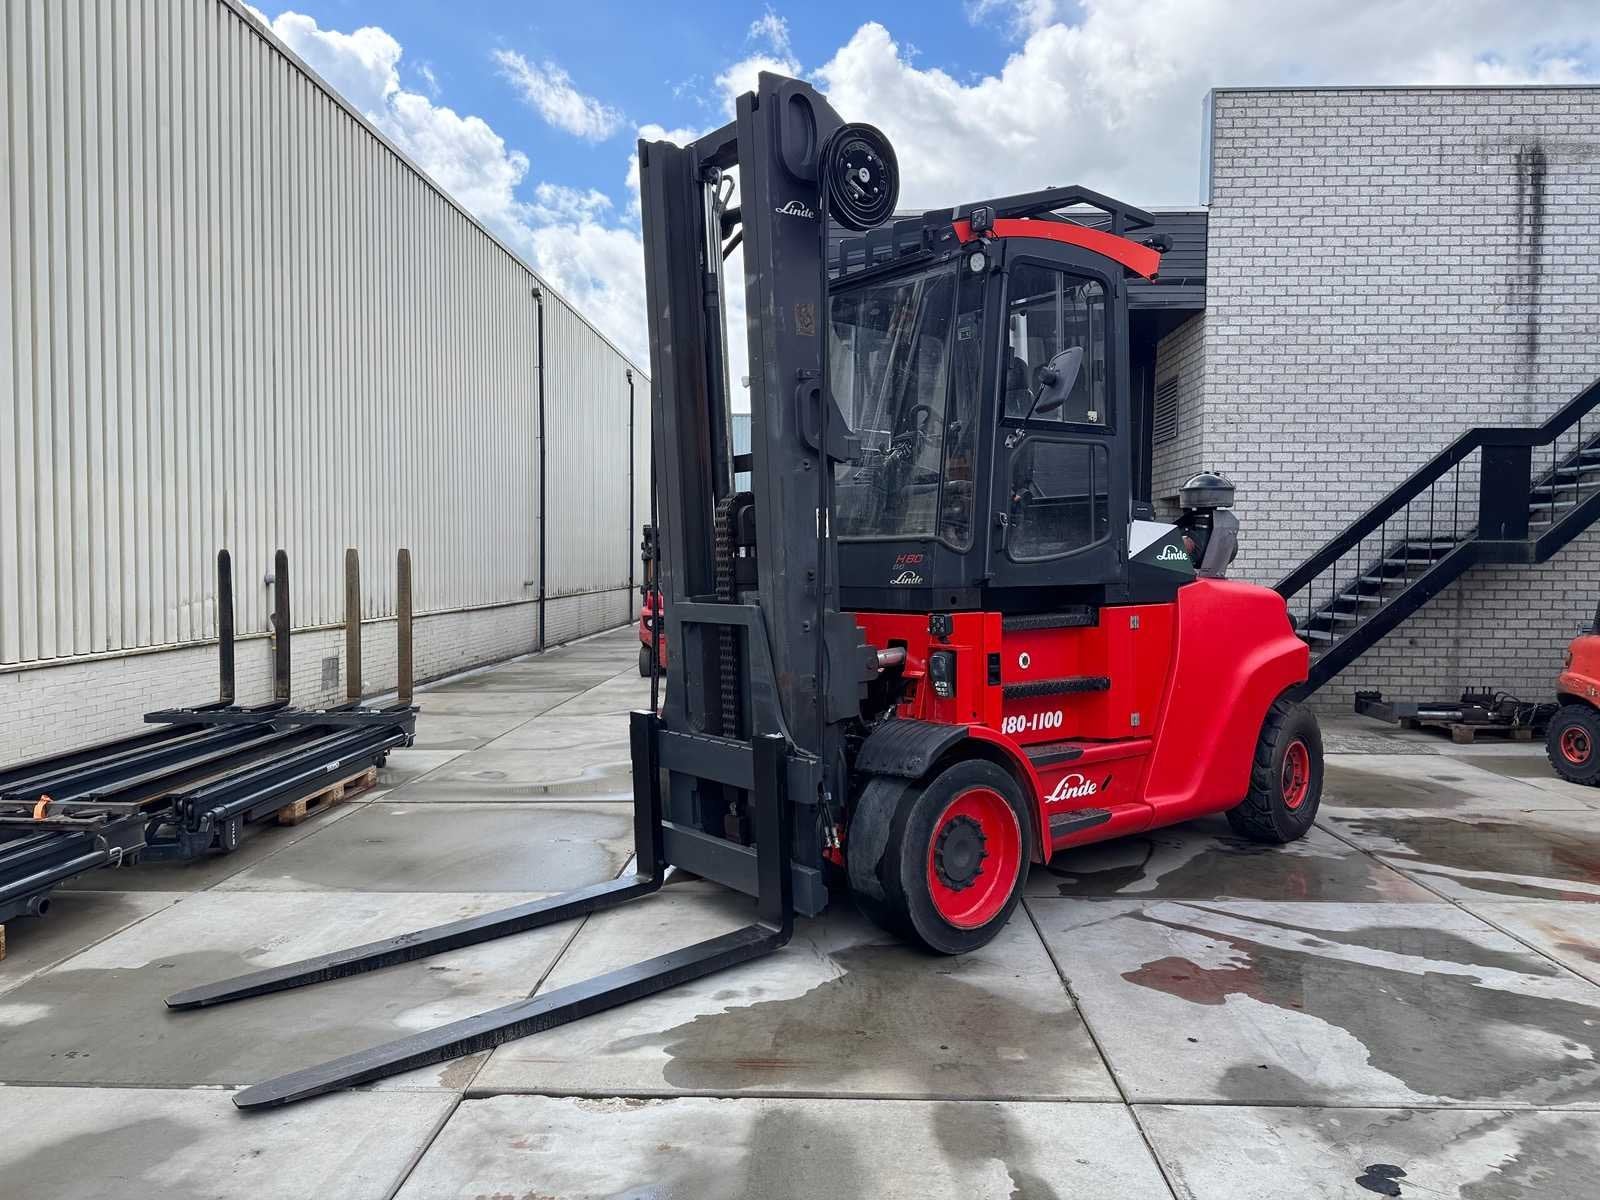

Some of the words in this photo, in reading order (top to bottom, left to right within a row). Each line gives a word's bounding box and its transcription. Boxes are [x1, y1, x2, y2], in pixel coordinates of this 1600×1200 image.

[775, 200, 815, 219] Linde
[1156, 544, 1188, 561] Linde
[889, 570, 923, 585] Linde
[1044, 773, 1097, 804] Linde
